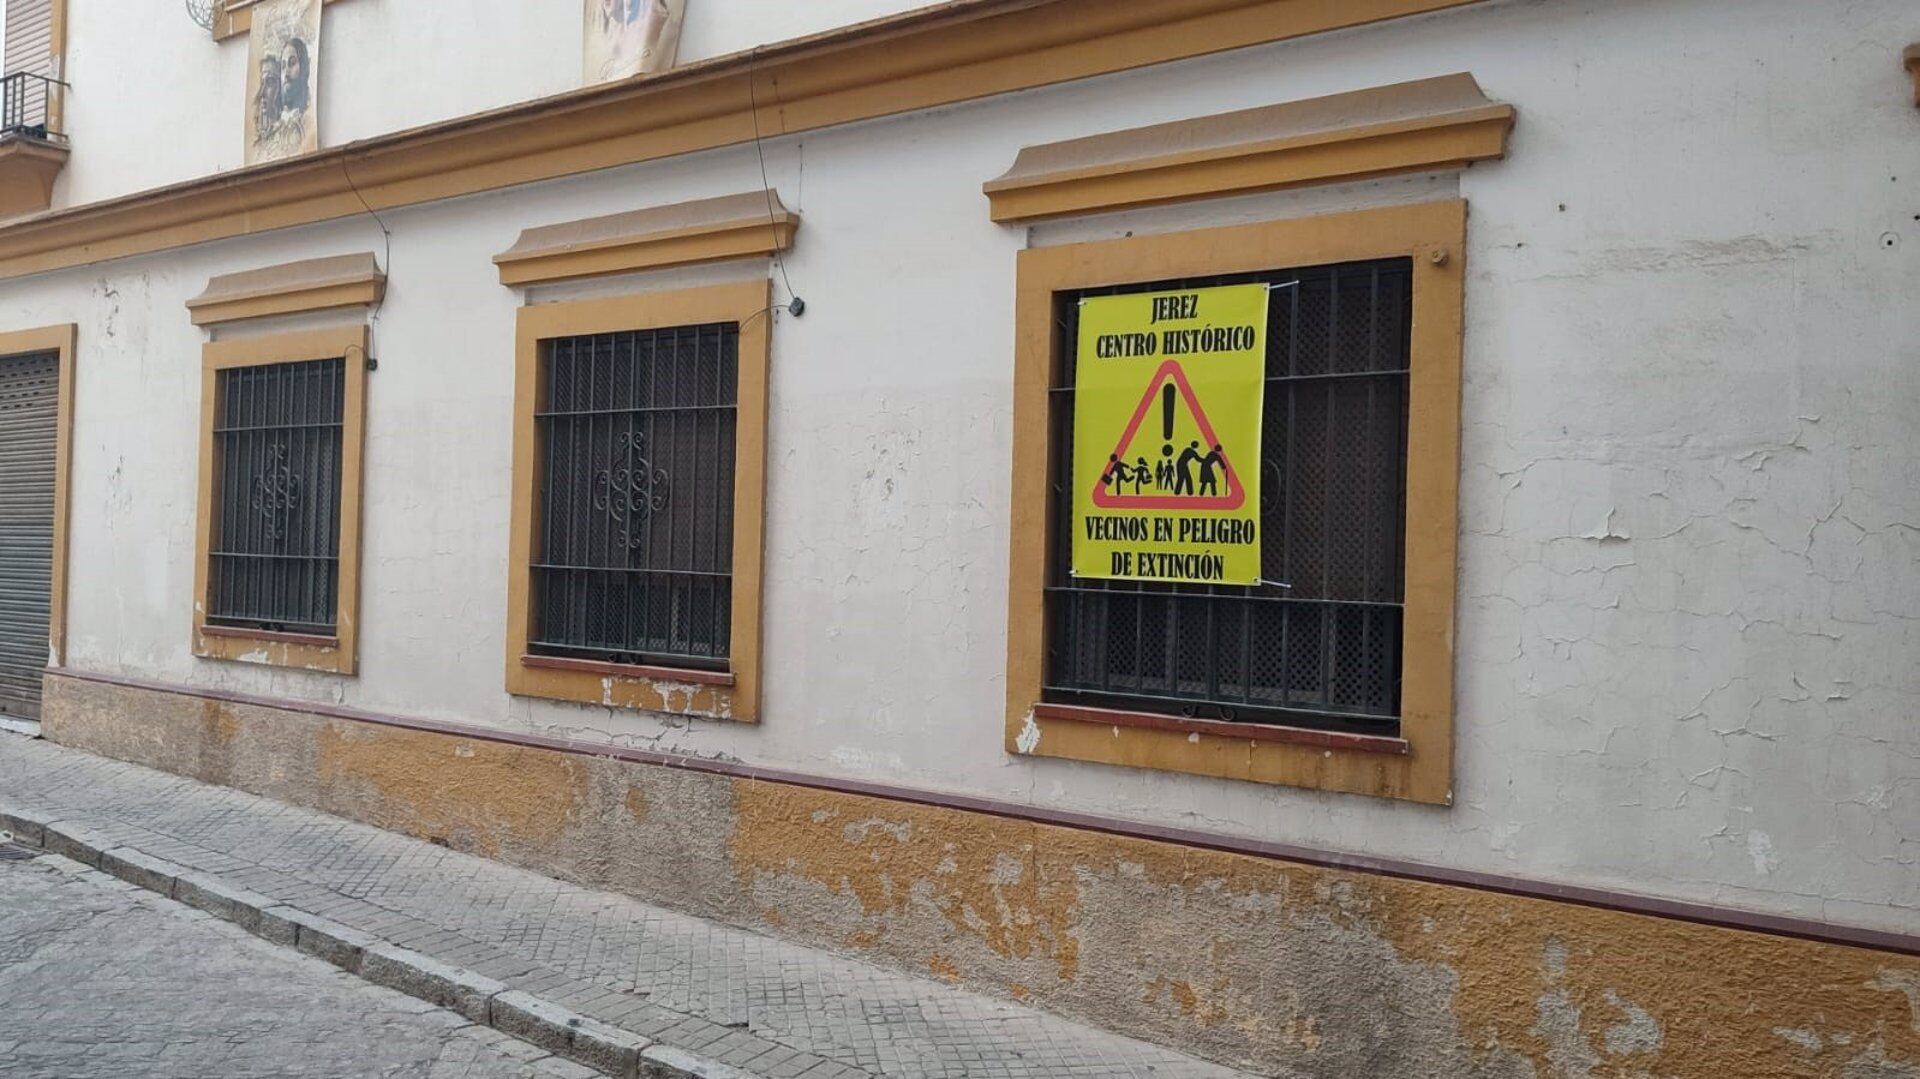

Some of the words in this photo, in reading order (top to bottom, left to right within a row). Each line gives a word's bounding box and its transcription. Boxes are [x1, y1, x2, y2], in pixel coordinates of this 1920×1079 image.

[1151, 294, 1199, 324] JEREZ
[1096, 331, 1157, 359] CENTRO
[1162, 323, 1256, 355] HISTÓRICO
[1085, 516, 1148, 541] VECINOS
[1153, 517, 1174, 542] EN
[1178, 518, 1256, 544] PELIGRO
[1111, 551, 1132, 576] DE
[1137, 550, 1224, 580] EXTINCIÓN
